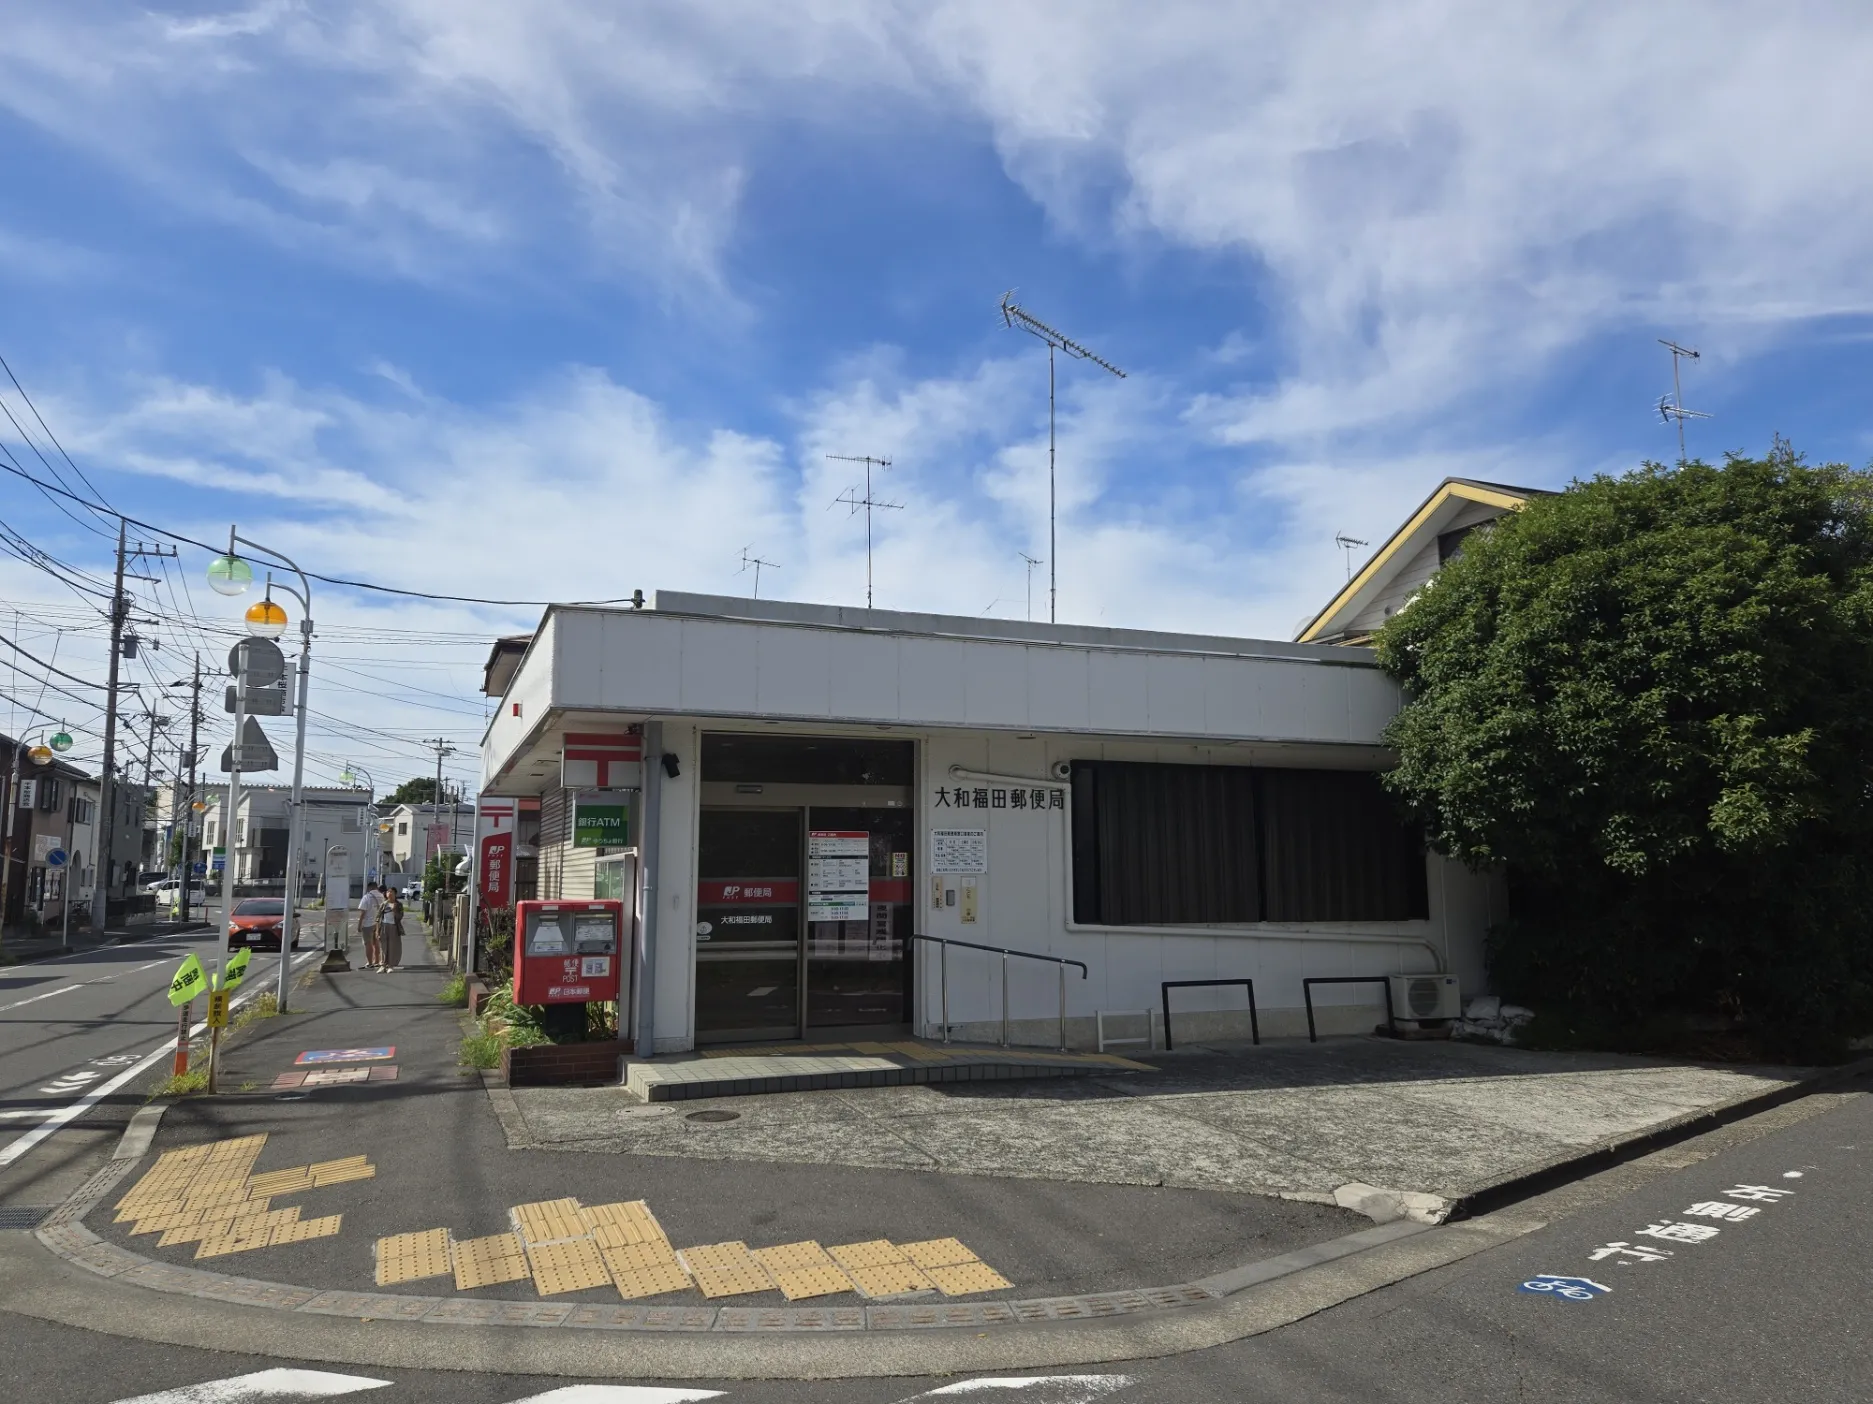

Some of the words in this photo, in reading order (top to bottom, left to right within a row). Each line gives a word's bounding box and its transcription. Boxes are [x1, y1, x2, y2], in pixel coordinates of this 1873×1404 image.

[934, 786, 1065, 810] 大和福田郵便局
[578, 817, 620, 827] 銀行ATM
[488, 860, 501, 892] 郵便局
[744, 888, 772, 898] 郵便局
[720, 915, 772, 924] 大和福田郵便局
[564, 958, 579, 967] 郵便
[1588, 1184, 1796, 1266] 左側通行
